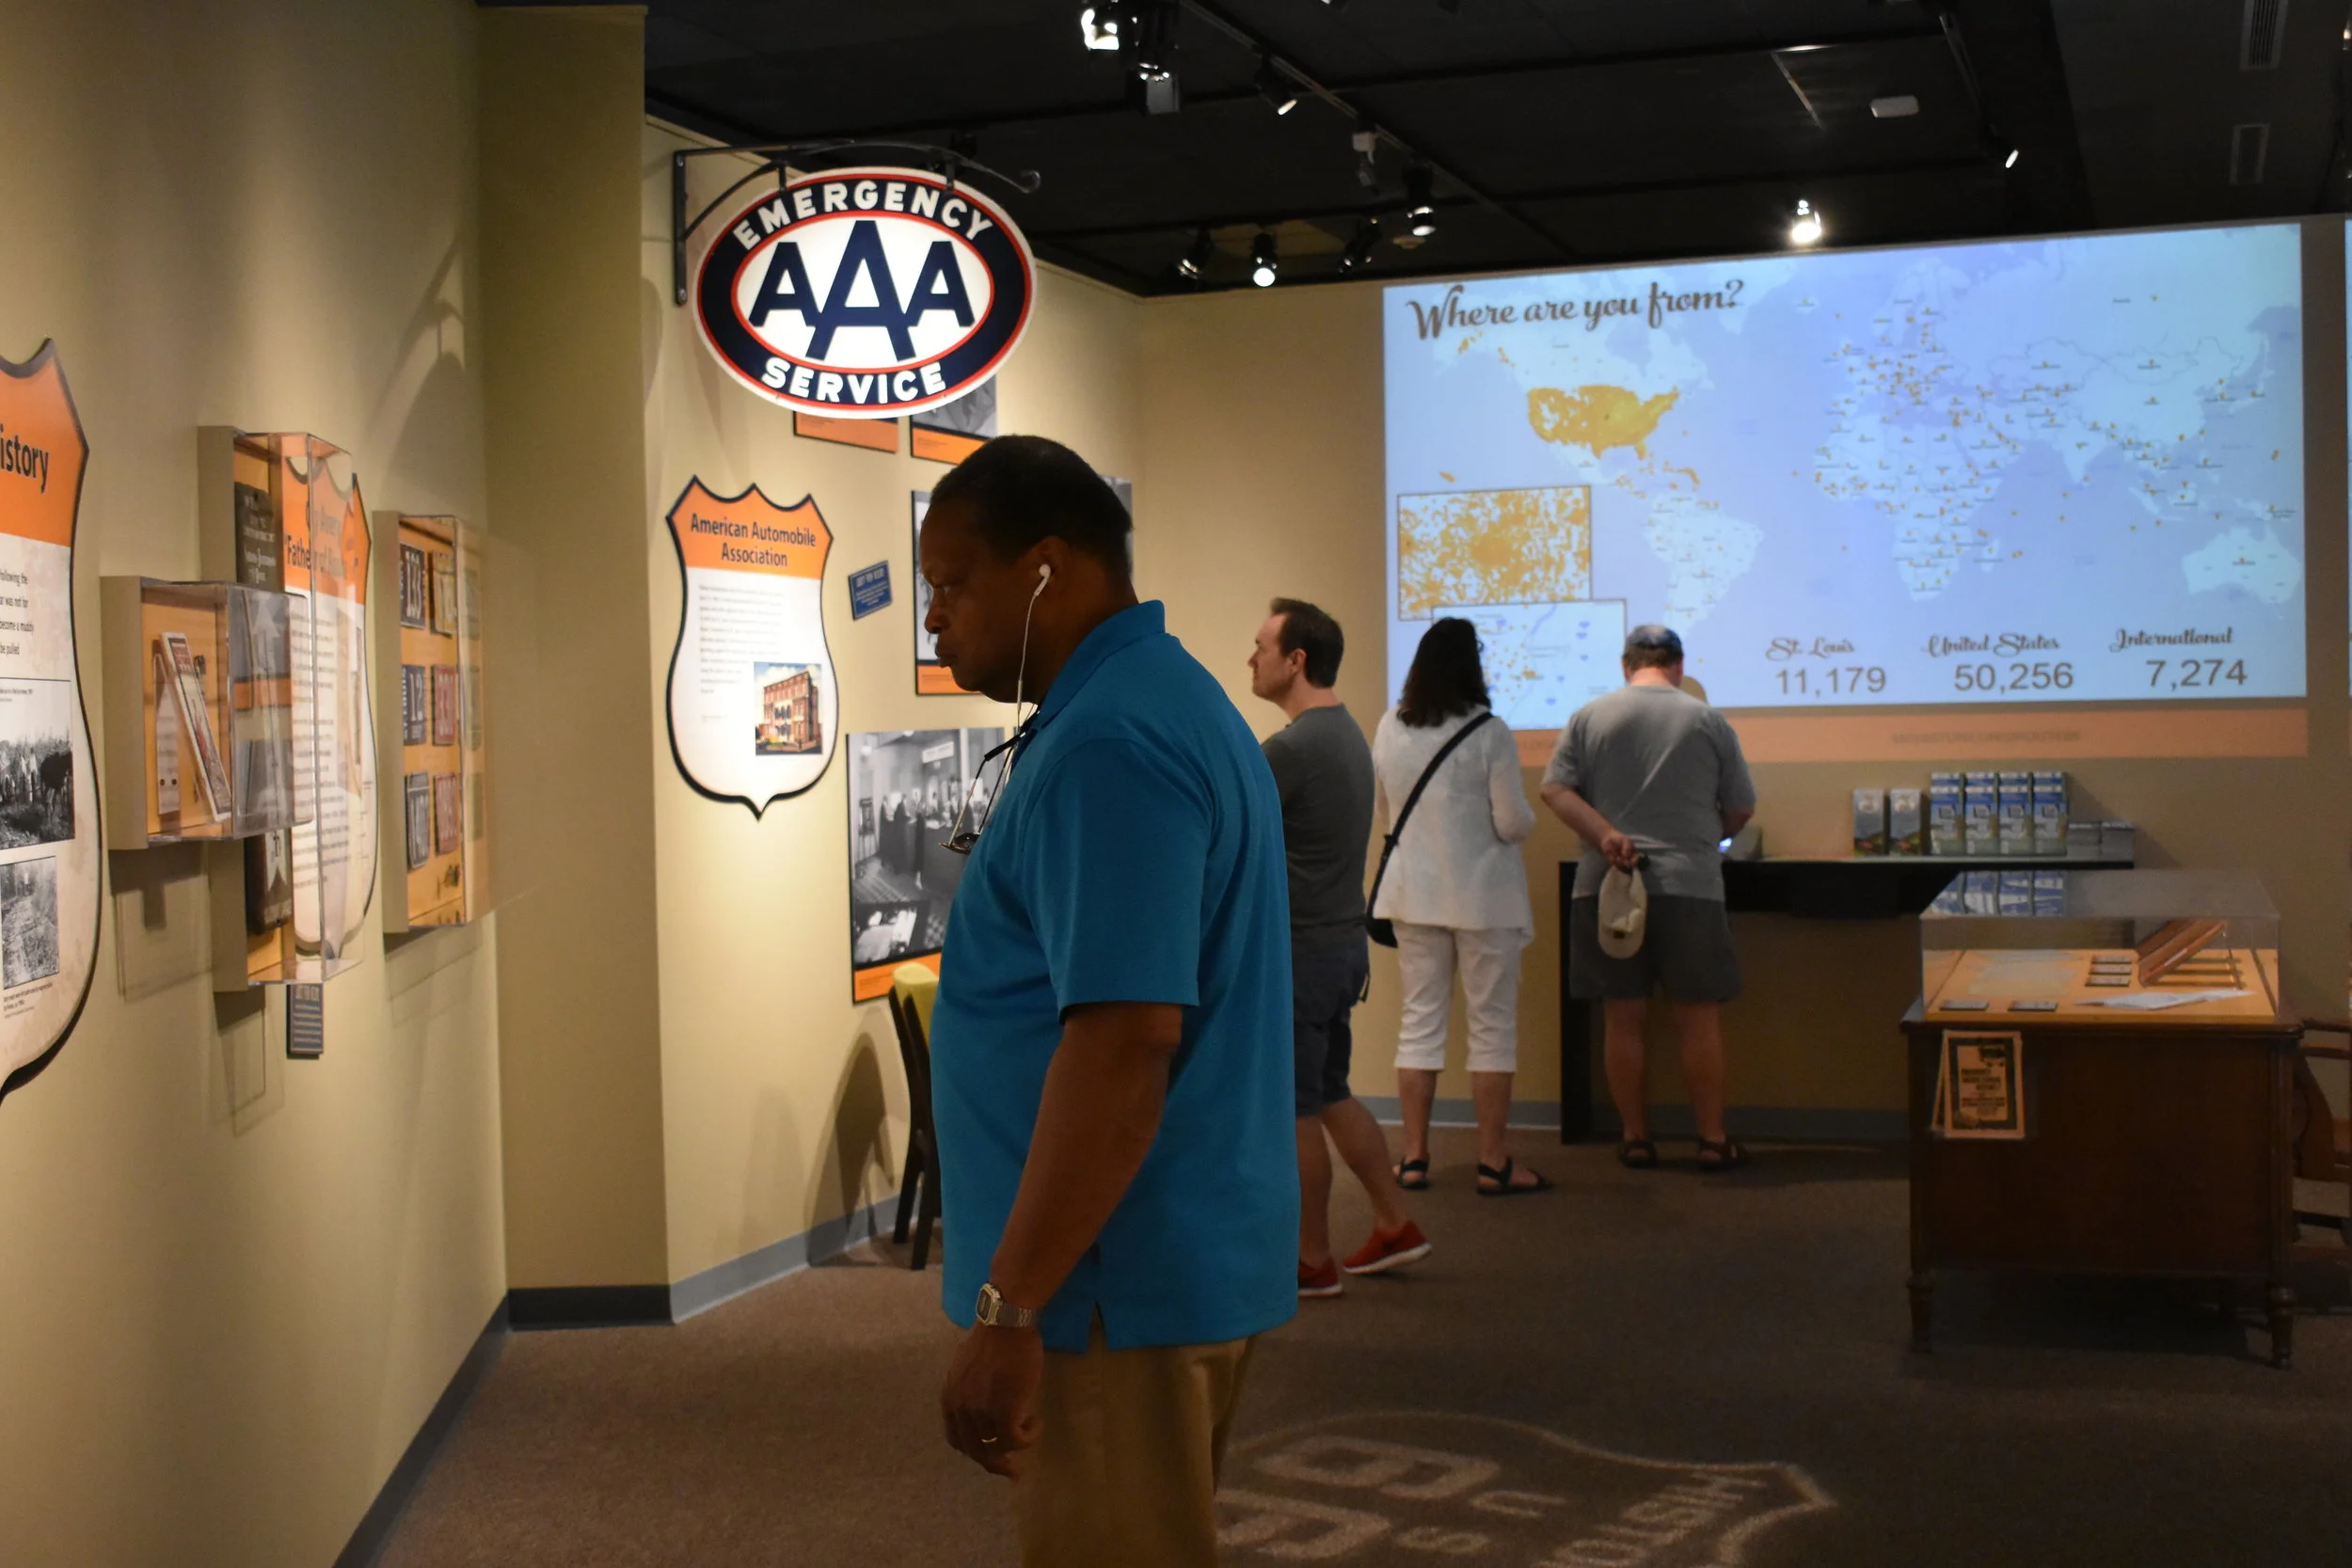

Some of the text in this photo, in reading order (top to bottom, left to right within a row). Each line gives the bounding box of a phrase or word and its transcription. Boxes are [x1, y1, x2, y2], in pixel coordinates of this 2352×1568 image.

[733, 180, 993, 250] EMERGENCY
[748, 219, 976, 362] AAA
[1406, 279, 1744, 341] Where are you from?
[761, 356, 946, 404] SERVICE
[691, 513, 817, 546] American Automobile
[722, 542, 787, 567] Association
[1808, 637, 1856, 658] Louis
[1921, 632, 2060, 658] United States
[2108, 626, 2233, 653] International
[1777, 666, 1887, 698] 11,179
[1954, 662, 2074, 694] 50,256
[2146, 658, 2248, 691] 7,274
